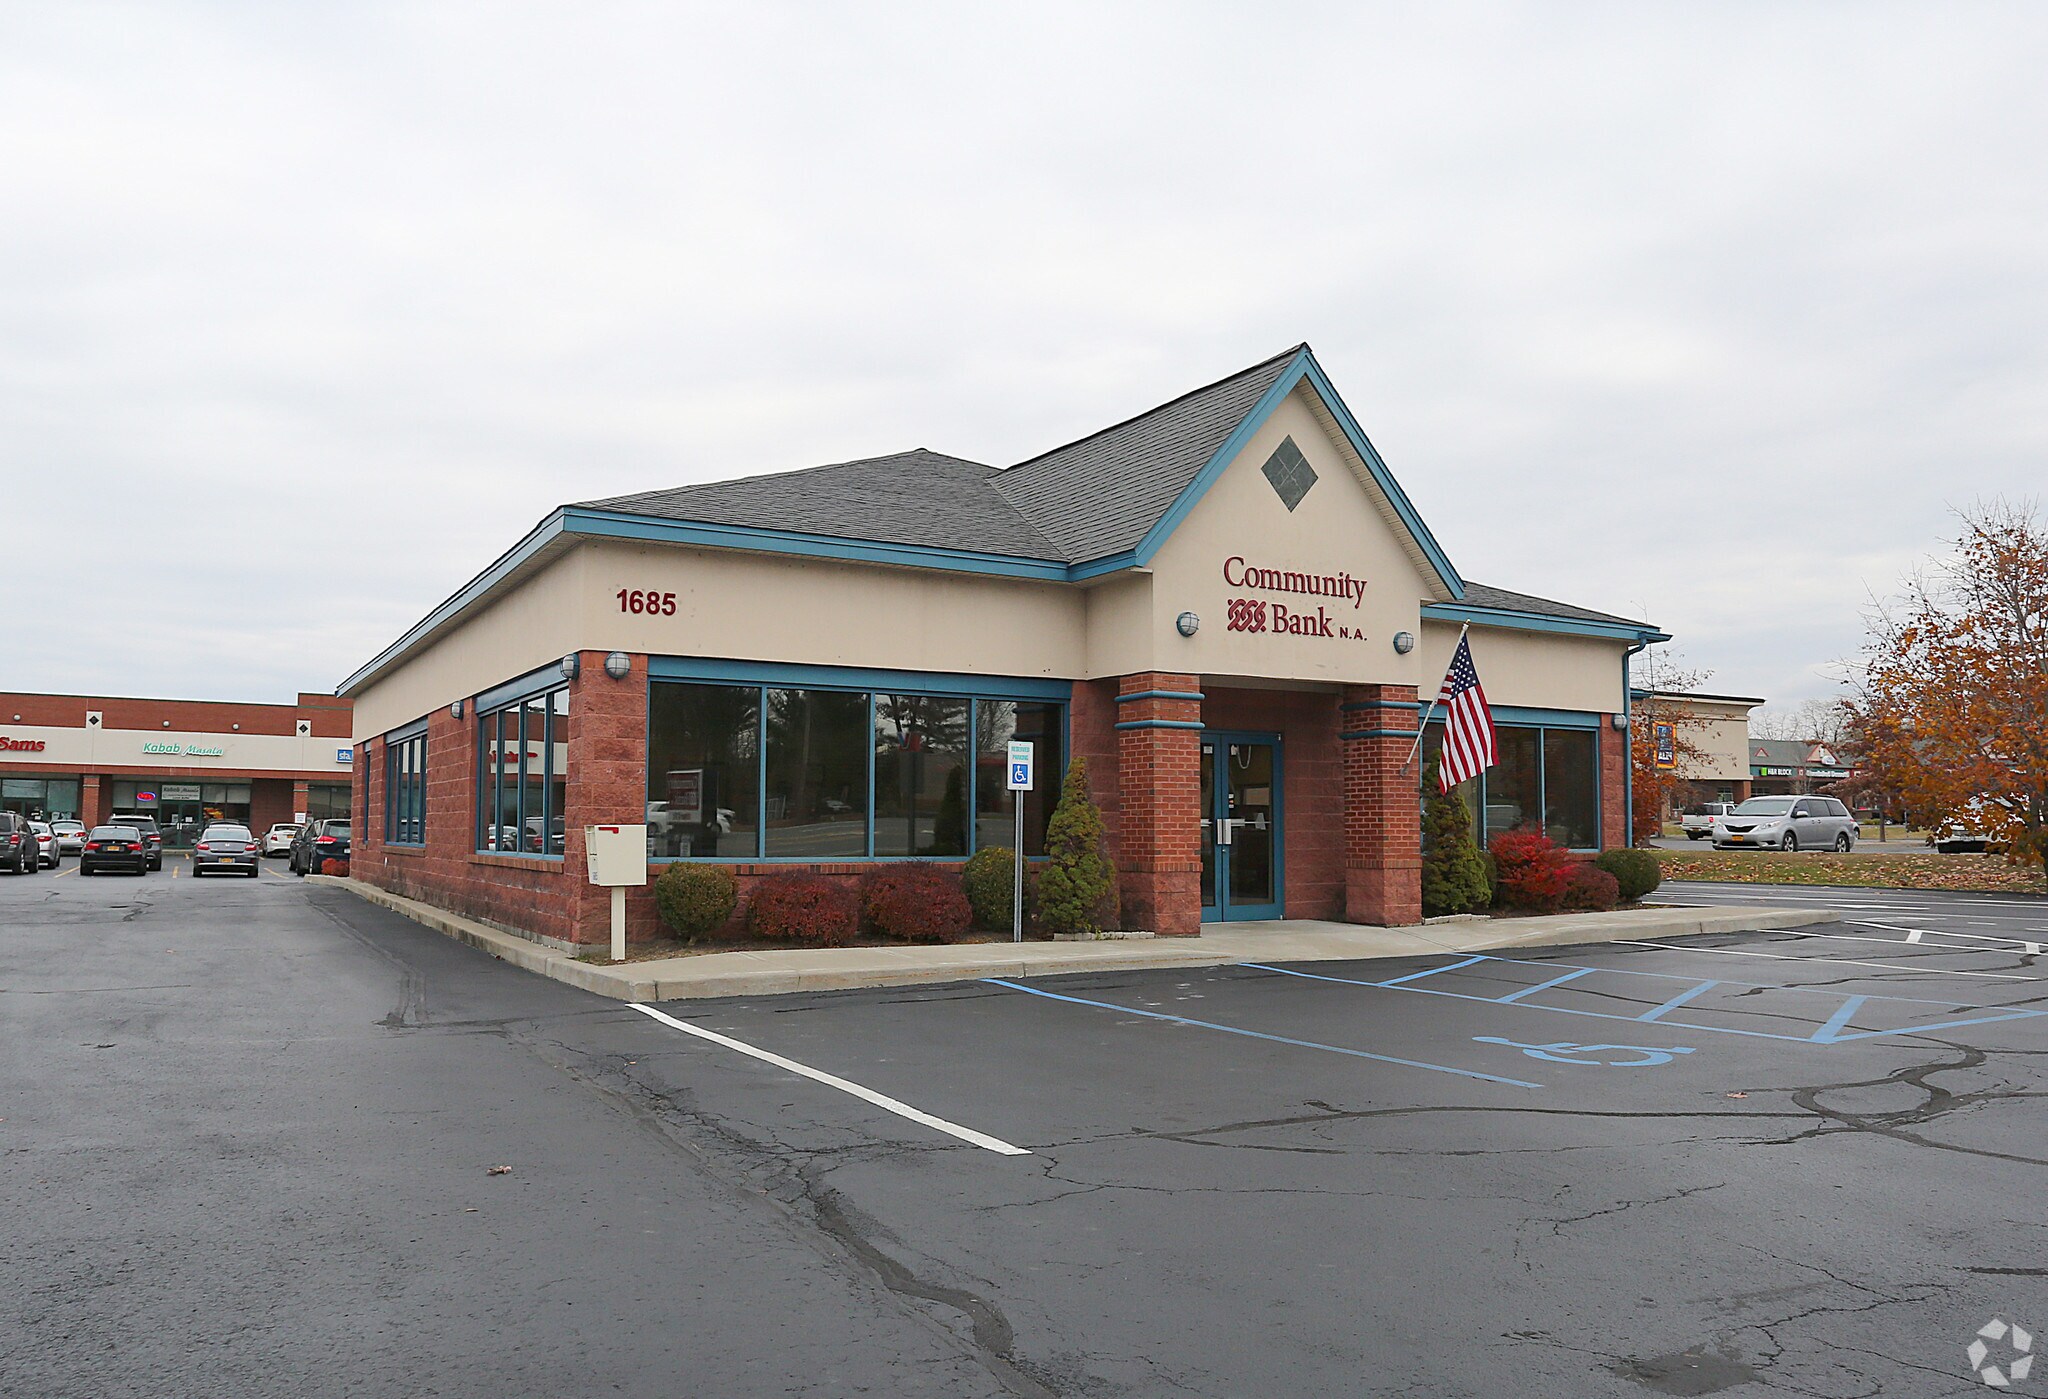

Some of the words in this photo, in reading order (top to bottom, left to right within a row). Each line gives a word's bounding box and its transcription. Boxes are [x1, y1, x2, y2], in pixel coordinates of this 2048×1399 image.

[1223, 556, 1368, 609] Community
[616, 588, 677, 616] 1685
[1271, 603, 1334, 638] Bank
[1339, 626, 1368, 641] N.A.
[0, 736, 46, 752] Sams
[143, 742, 181, 754] Kabab
[181, 744, 224, 757] Masala
[1777, 768, 1792, 776] BLOCK
